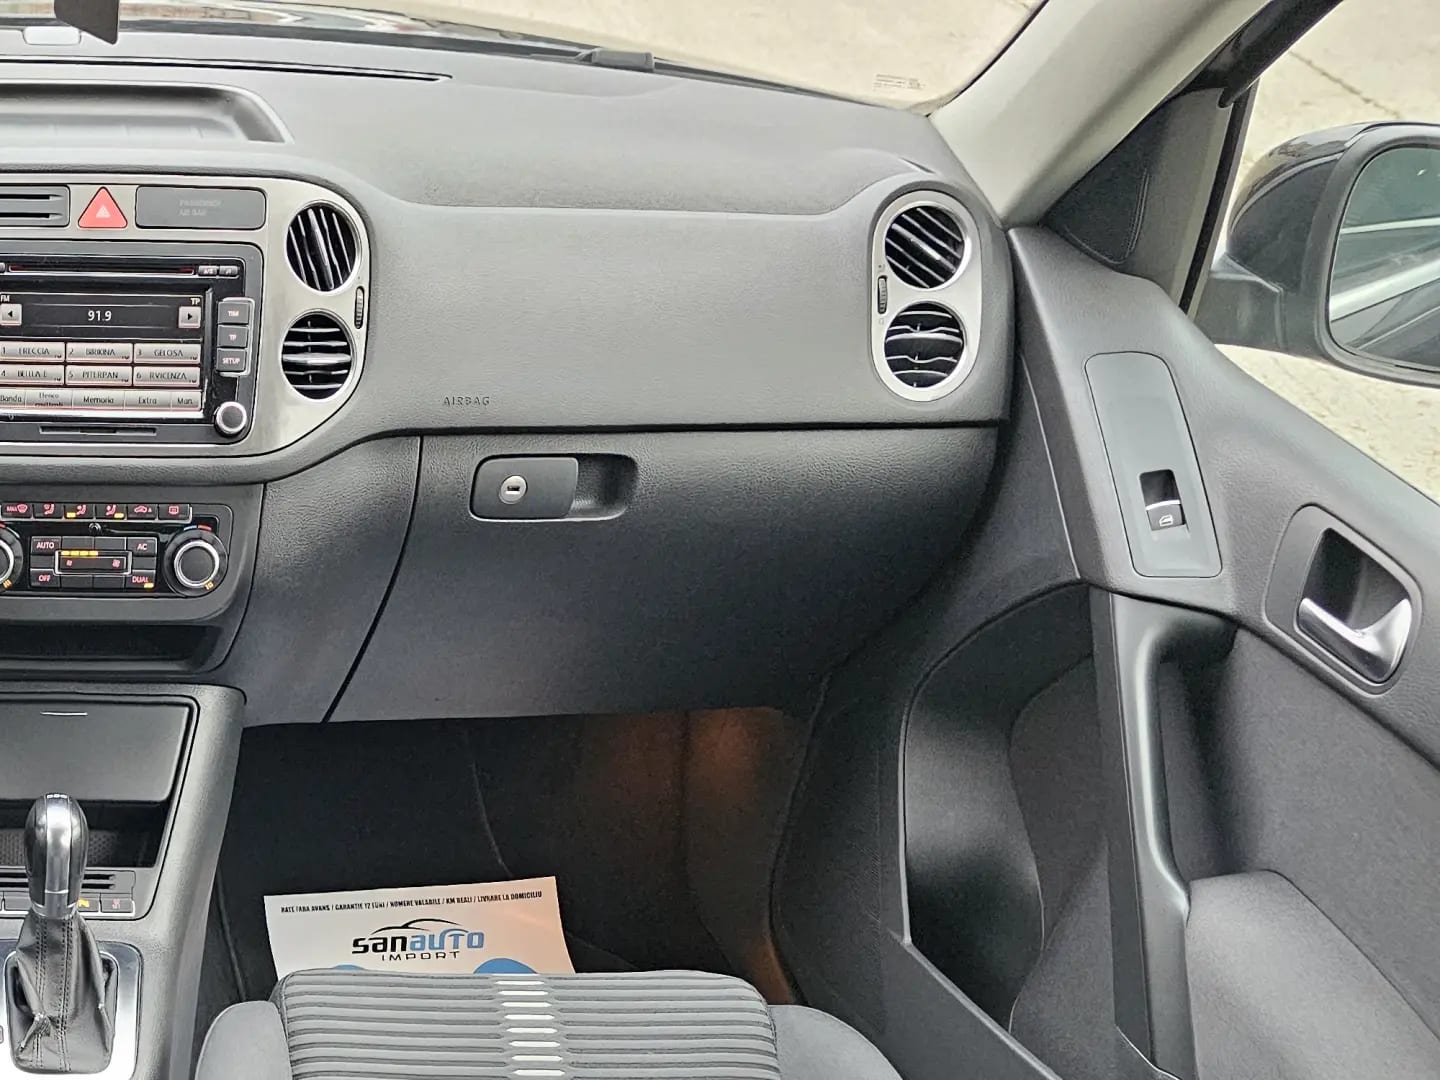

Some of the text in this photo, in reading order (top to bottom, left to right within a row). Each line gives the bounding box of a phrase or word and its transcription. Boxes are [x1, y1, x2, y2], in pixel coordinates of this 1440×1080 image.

[87, 310, 112, 321] 91.9
[443, 396, 490, 406] AIRBAG
[335, 903, 363, 911] GARANTIE
[381, 950, 460, 961] IMPORT
